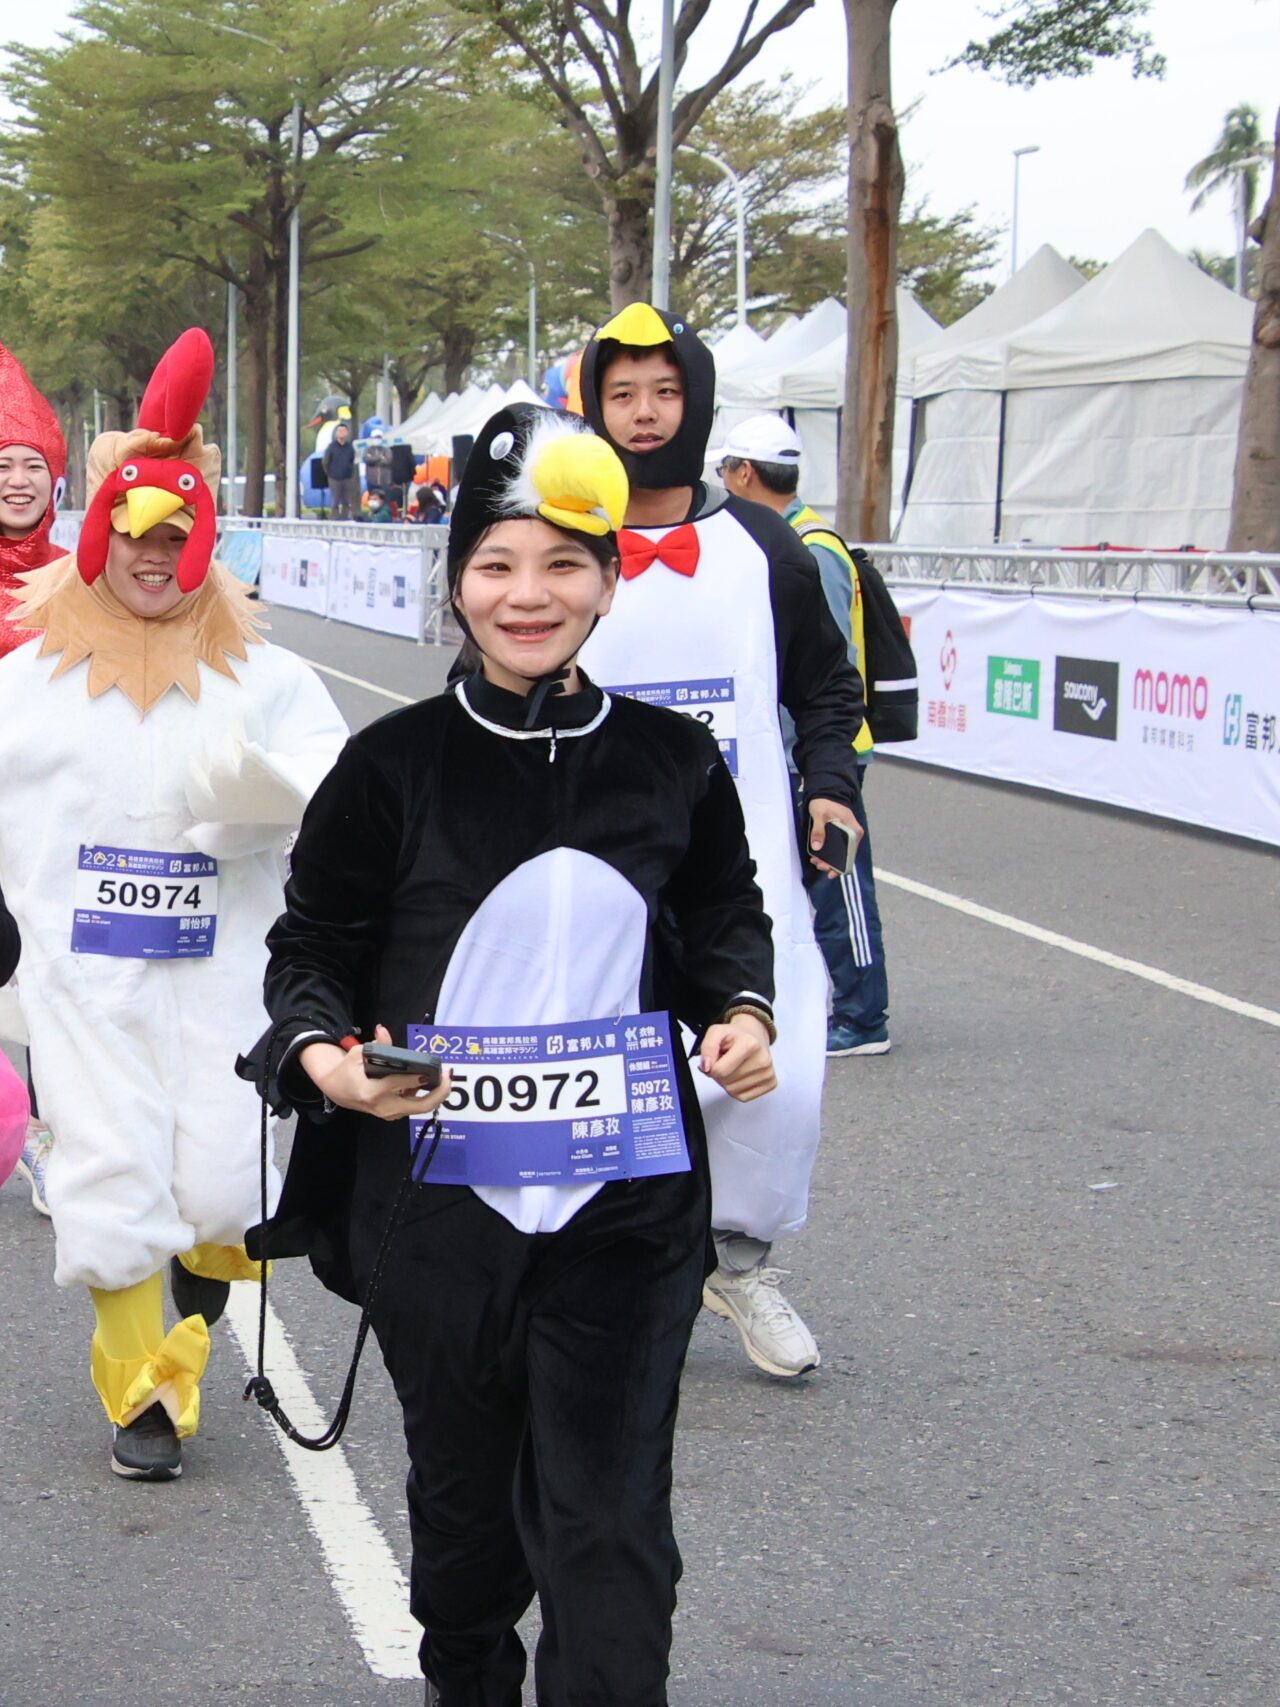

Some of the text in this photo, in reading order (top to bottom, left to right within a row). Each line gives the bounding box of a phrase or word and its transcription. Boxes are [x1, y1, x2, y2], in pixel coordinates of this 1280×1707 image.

[1064, 681, 1098, 704] saucony
[1133, 668, 1209, 721] momo
[1246, 711, 1280, 754] 富邦
[97, 880, 201, 909] 50974
[414, 1033, 479, 1055] 2025
[567, 1033, 616, 1053] 富邦人壽
[443, 1070, 600, 1112] 50972
[631, 1079, 670, 1096] 50972
[572, 1117, 620, 1140] 陳彥孜
